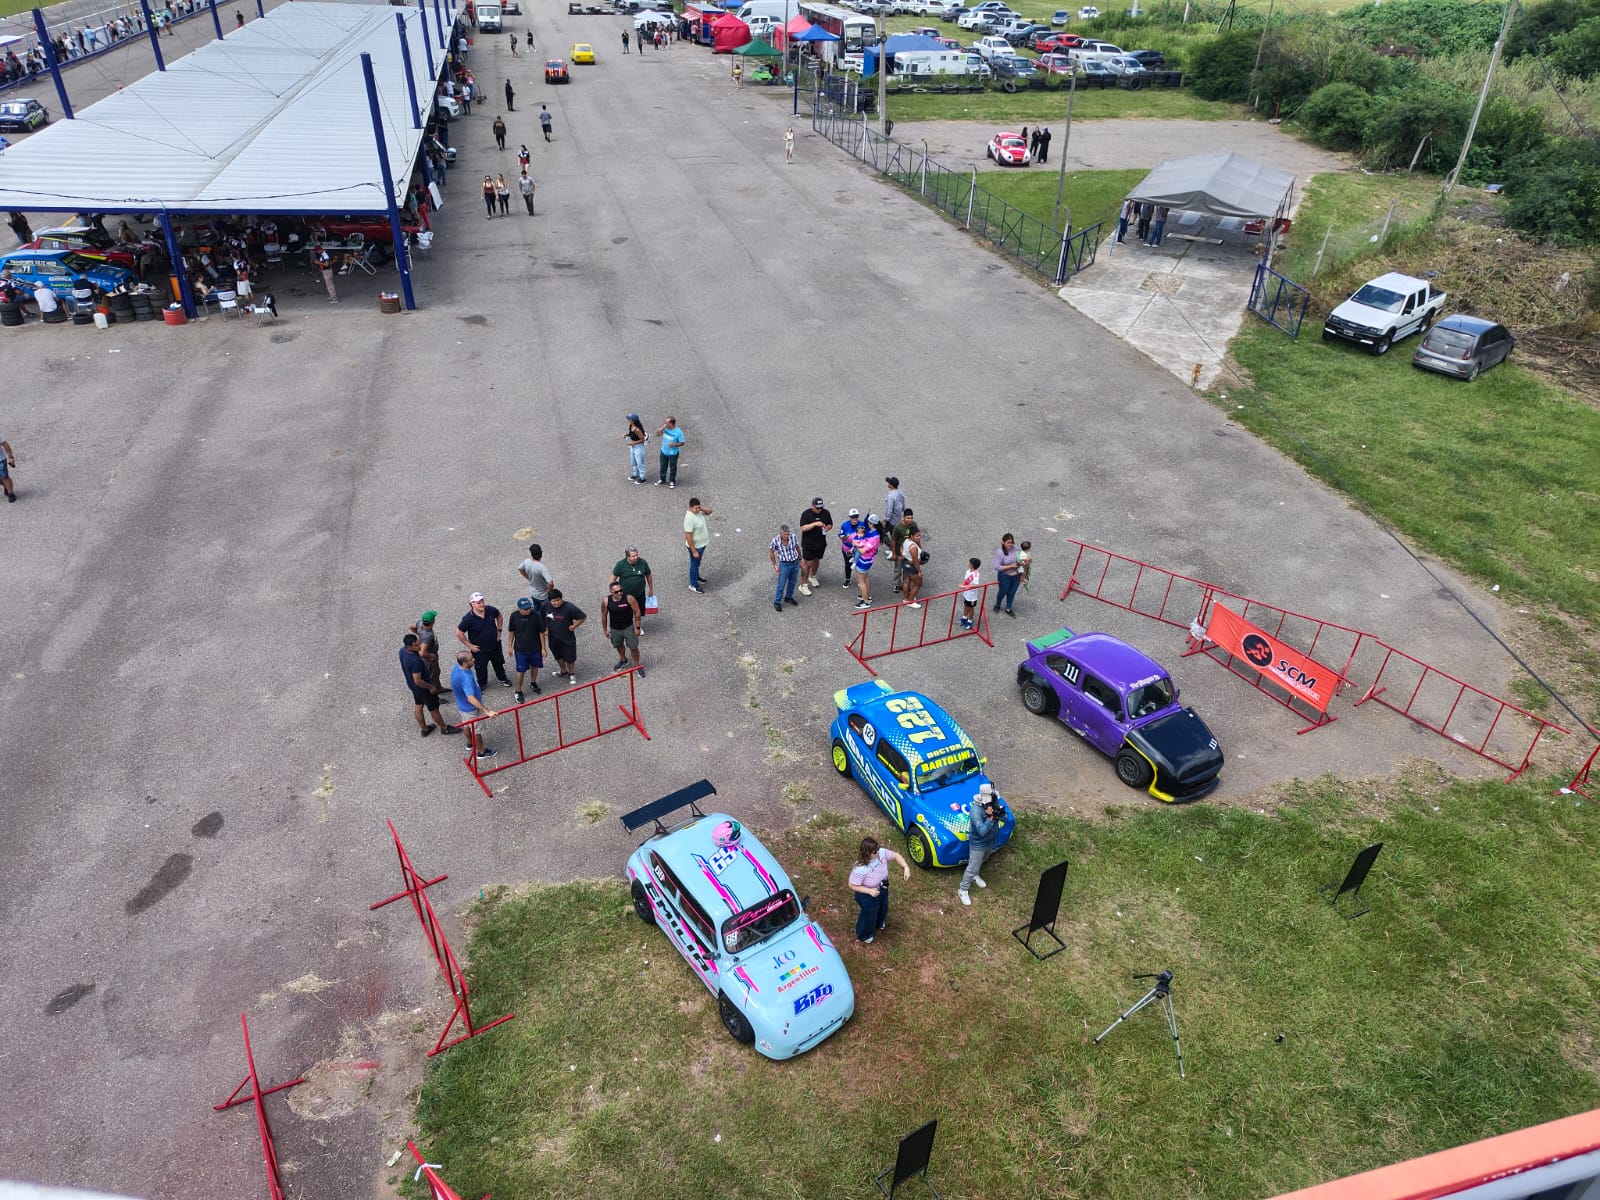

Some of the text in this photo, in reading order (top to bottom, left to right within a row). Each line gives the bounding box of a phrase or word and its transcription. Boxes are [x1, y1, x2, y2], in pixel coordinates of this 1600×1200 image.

[1063, 663, 1079, 683] 111
[1276, 659, 1317, 690] SCM
[885, 695, 948, 745] 122
[864, 724, 875, 741] 122
[921, 750, 971, 773] BARTOLINI
[926, 743, 962, 760] DOCTOR
[644, 881, 710, 972] EMILIA
